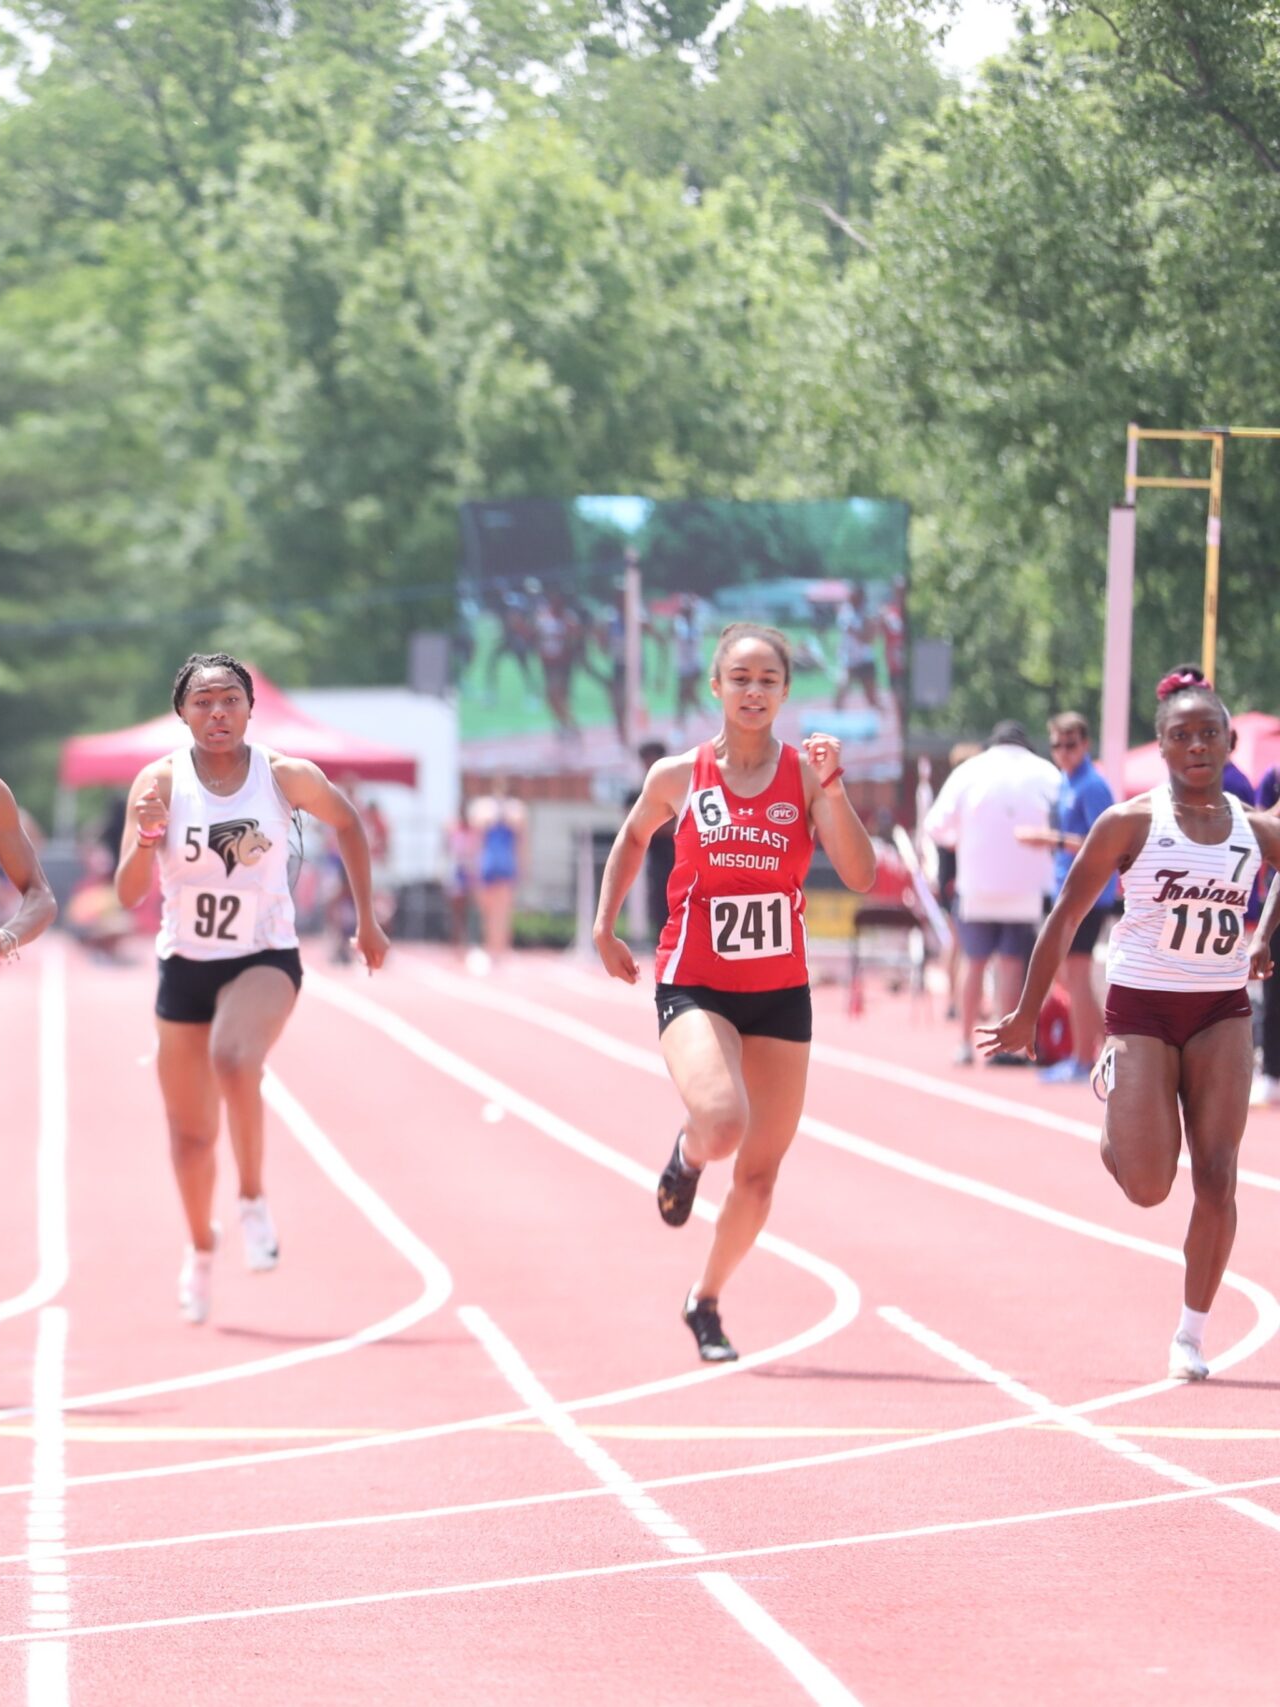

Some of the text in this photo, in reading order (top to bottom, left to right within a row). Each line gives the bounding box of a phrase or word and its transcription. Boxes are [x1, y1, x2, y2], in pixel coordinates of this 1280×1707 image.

[699, 790, 722, 827] 6
[185, 826, 202, 862] 5
[700, 825, 790, 852] SOUTHEAST
[709, 852, 780, 871] MISSOURI
[1229, 845, 1251, 882] 7
[1152, 869, 1248, 907] Trojans
[194, 893, 240, 940] 92
[715, 898, 782, 953] 241
[1170, 903, 1240, 955] 119
